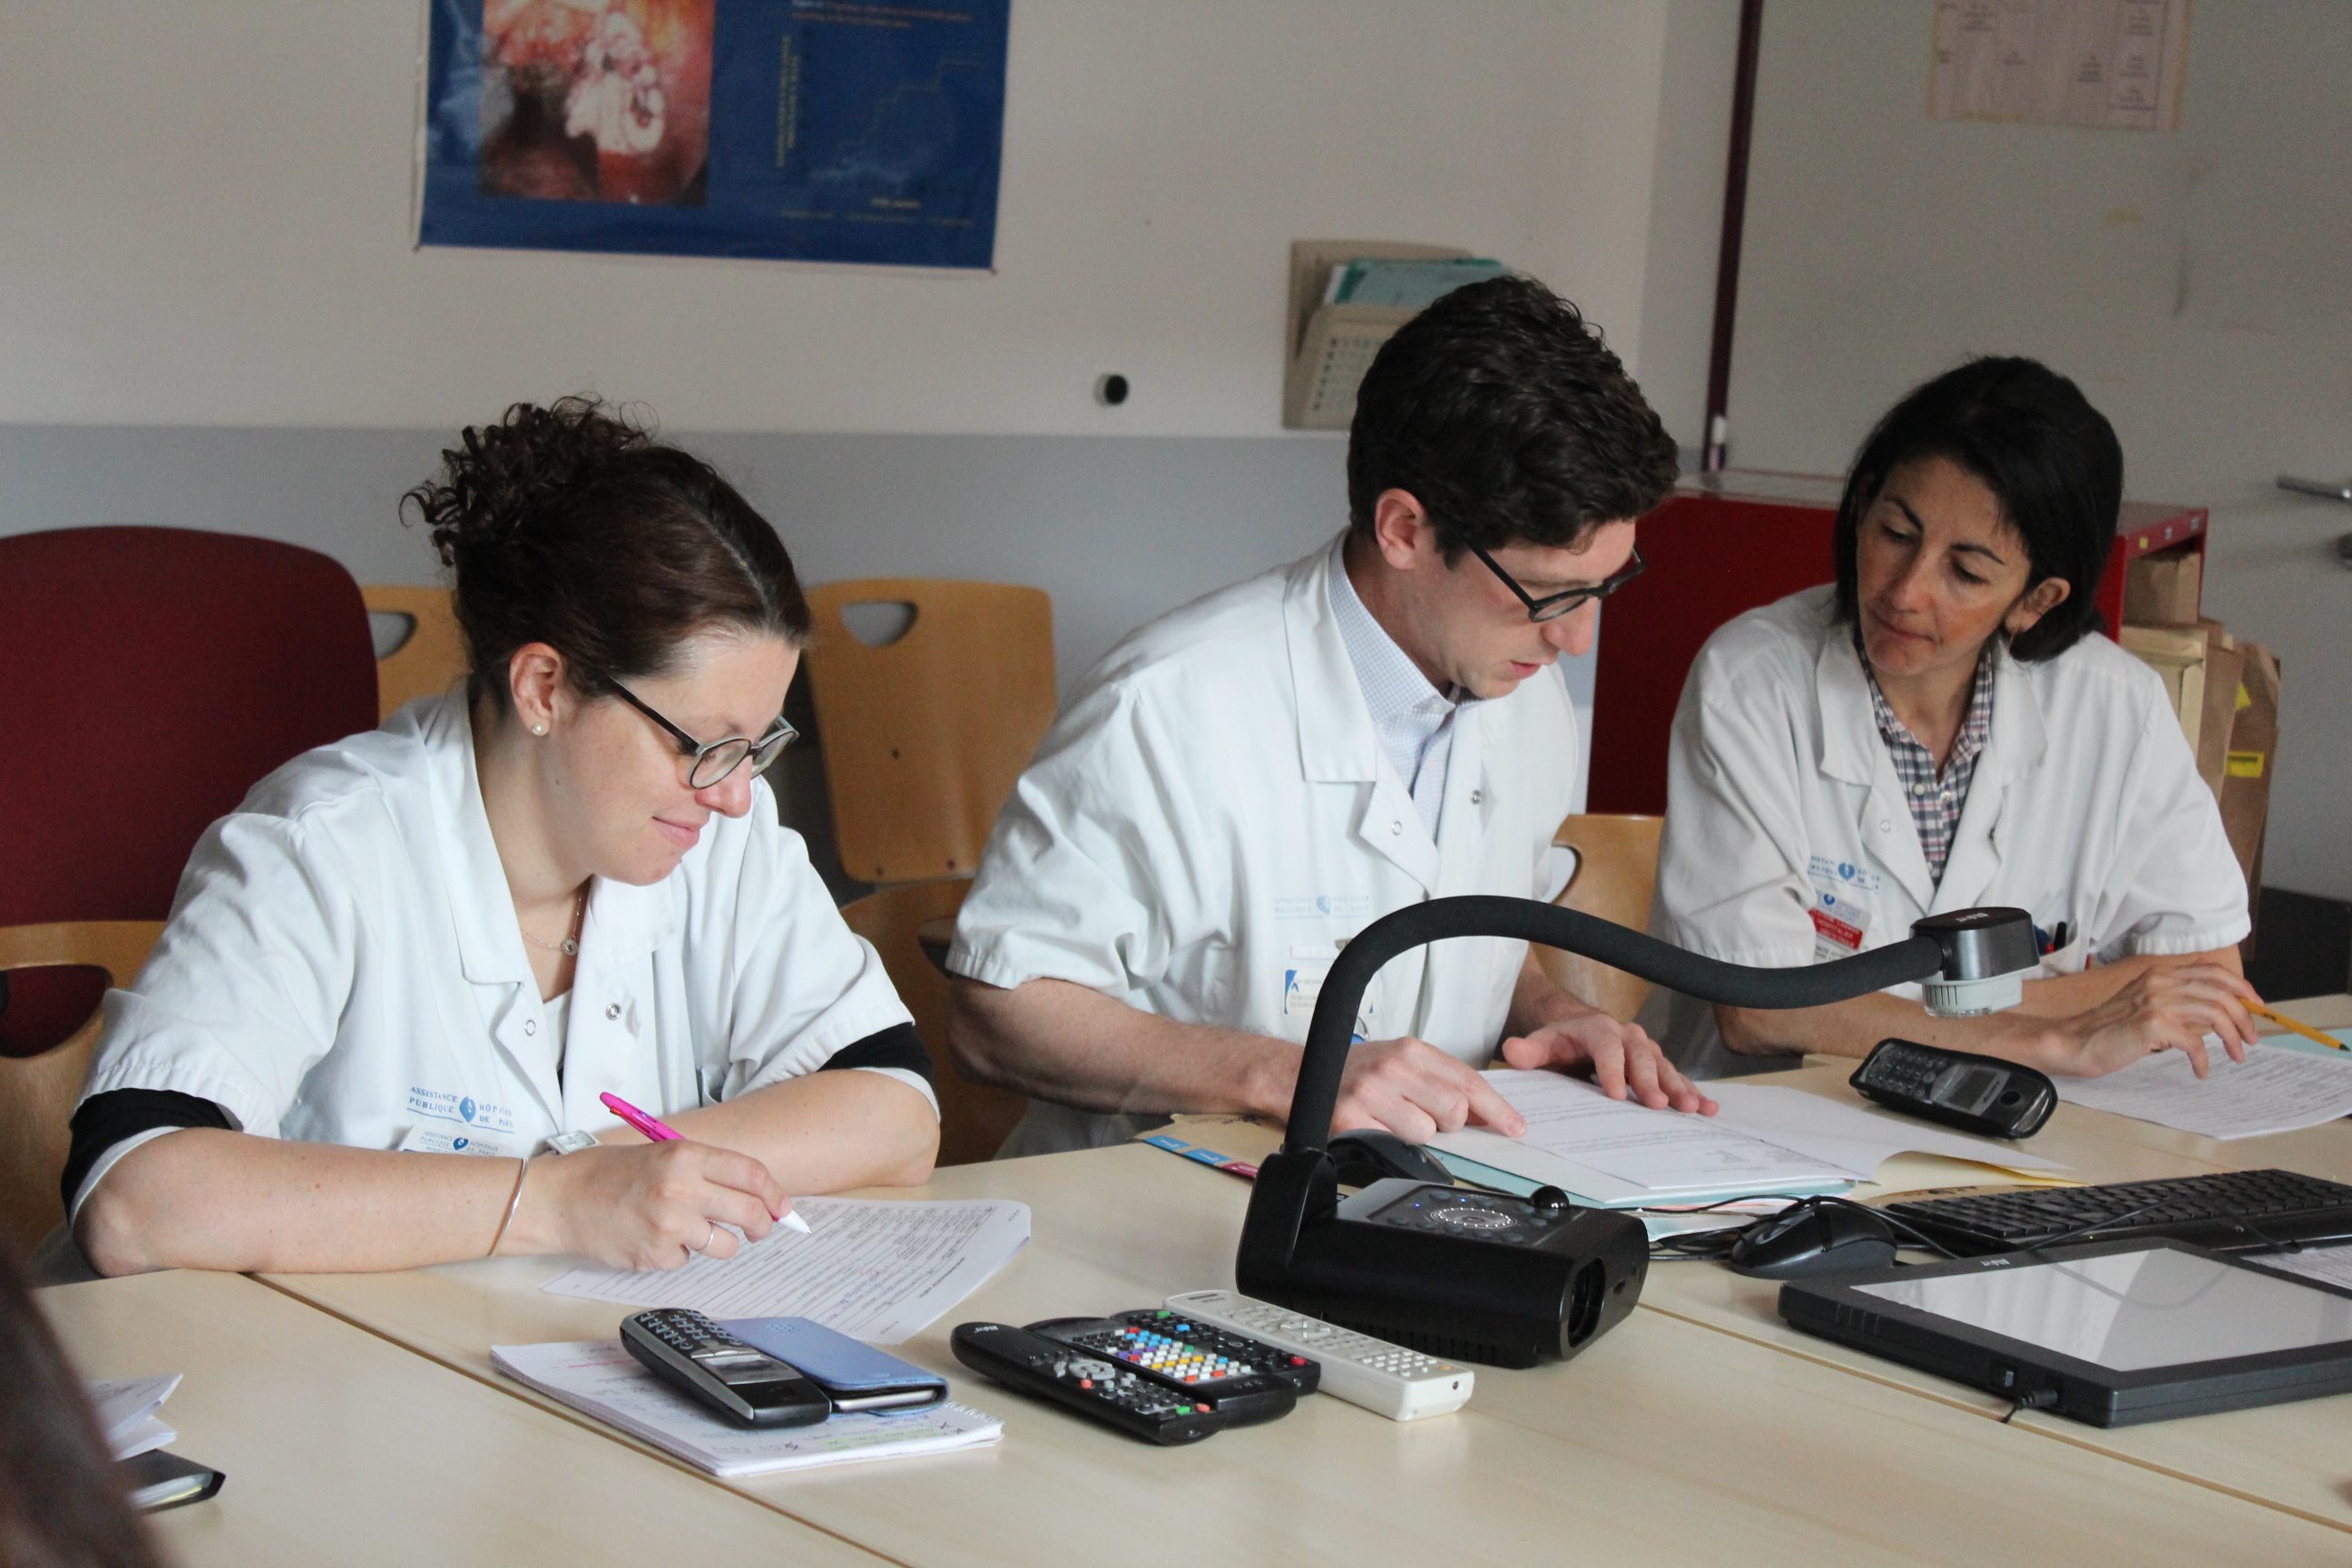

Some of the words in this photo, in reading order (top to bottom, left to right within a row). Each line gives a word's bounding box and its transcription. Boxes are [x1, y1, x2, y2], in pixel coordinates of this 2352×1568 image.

[410, 1086, 458, 1103] ASSISTANCE
[409, 1097, 455, 1113] PUBLIQUE
[479, 1115, 490, 1123] DE
[419, 1136, 451, 1147] PUBLIQUE
[424, 1131, 454, 1142] ASSISTANCE
